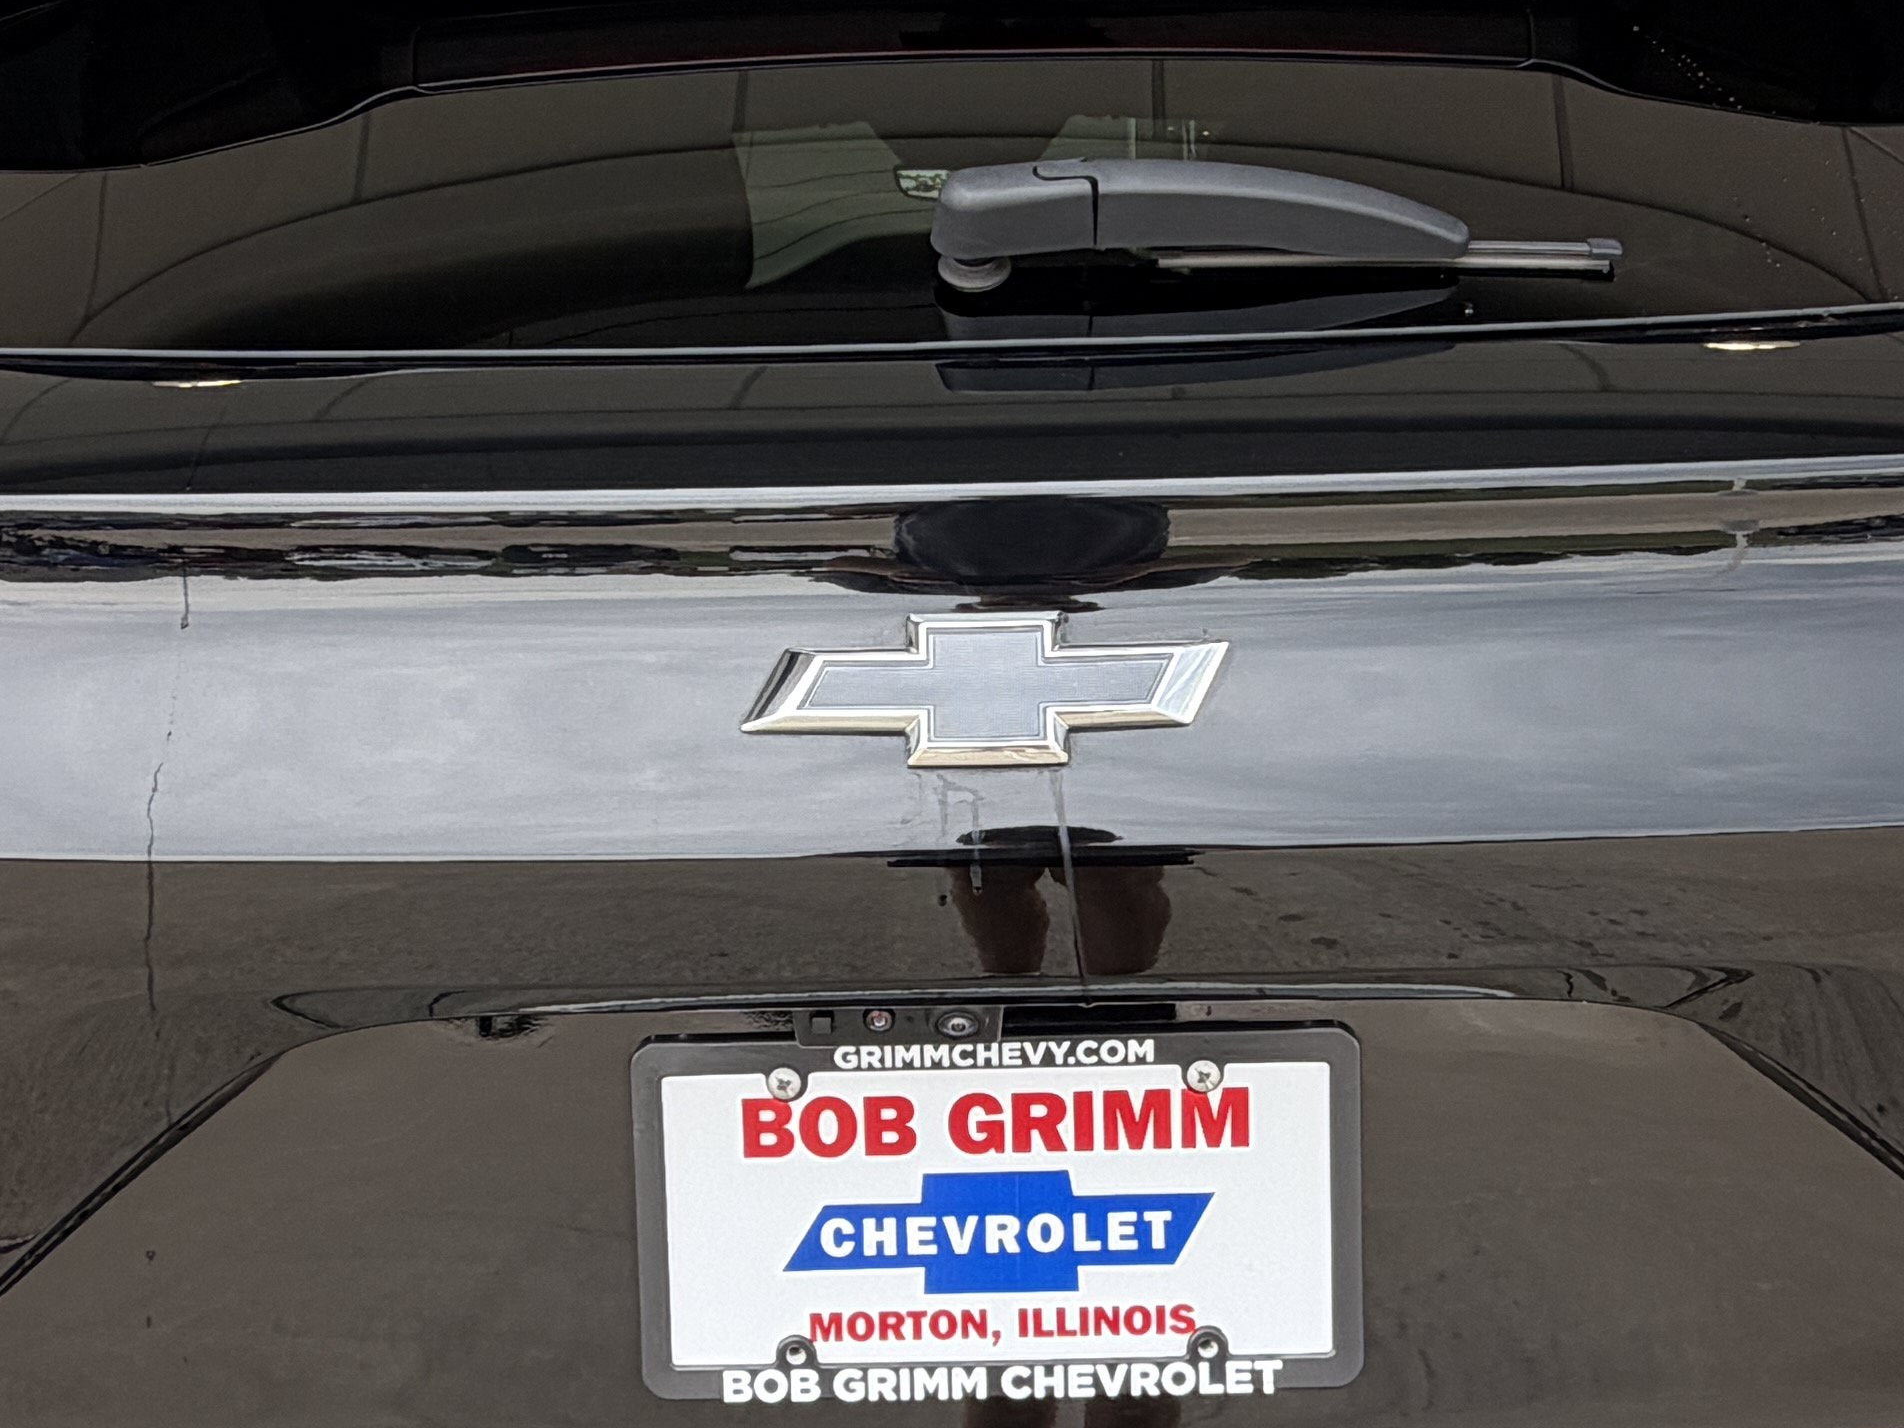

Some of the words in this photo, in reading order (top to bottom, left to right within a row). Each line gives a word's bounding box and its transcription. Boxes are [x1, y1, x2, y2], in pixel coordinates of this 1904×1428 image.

[834, 1039, 1154, 1069] GRIMMCHEVY.COM
[741, 1095, 917, 1159] BOB
[948, 1086, 1250, 1154] GRIMM
[820, 1210, 1172, 1257] CHEVROLET
[809, 1308, 1001, 1346] MORTON,
[1018, 1303, 1196, 1338] ILLINOIS
[723, 1369, 820, 1403] BOB
[833, 1365, 989, 1402] GRIMM
[1001, 1359, 1283, 1399] CHEVROLET
